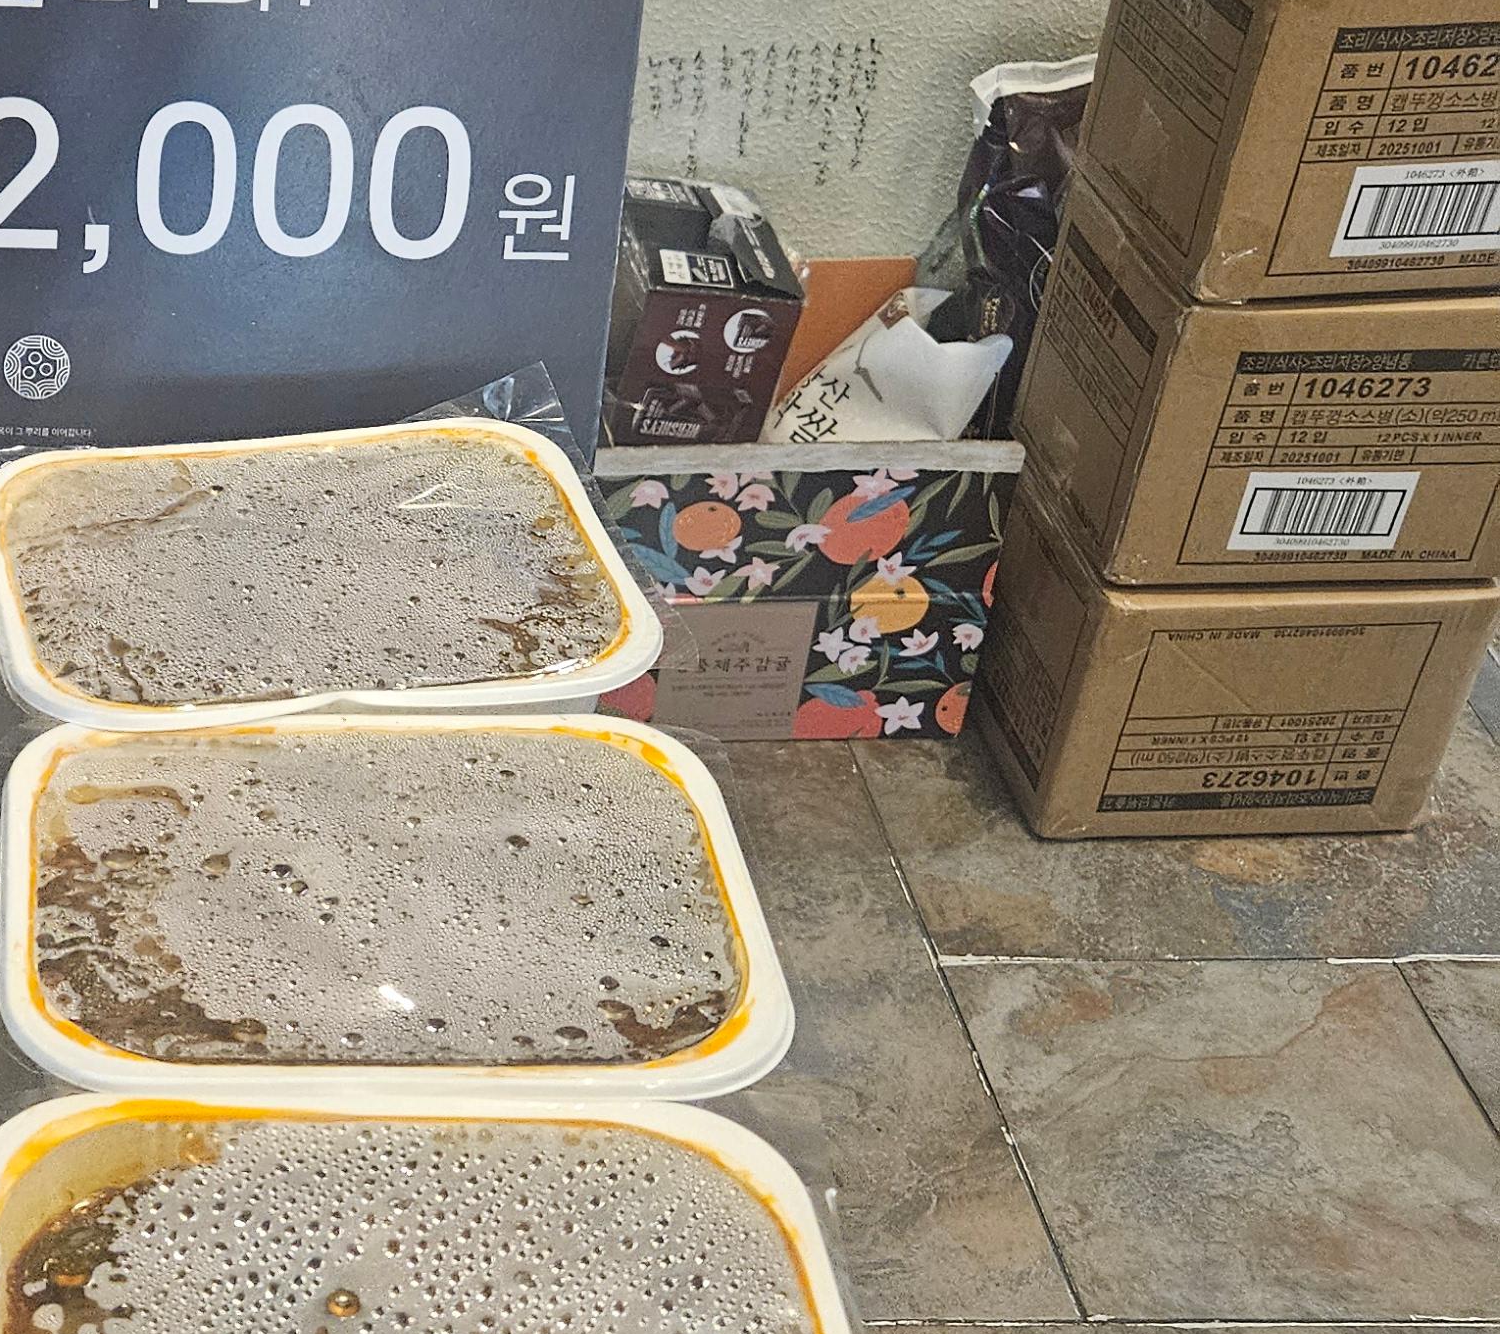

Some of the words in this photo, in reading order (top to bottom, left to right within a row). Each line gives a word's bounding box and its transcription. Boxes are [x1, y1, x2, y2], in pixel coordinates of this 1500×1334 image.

[1378, 140, 1442, 156] 20251001
[497, 170, 578, 261] 원
[1459, 252, 1497, 264] MADE
[1303, 376, 1433, 399] 1046273
[1279, 452, 1341, 463] 20251001
[1361, 550, 1397, 560] MADE
[1400, 550, 1414, 559] IN
[1419, 550, 1457, 560] CHINA
[1167, 632, 1201, 641] CHINA
[1208, 631, 1223, 640] IN
[1225, 630, 1260, 640] MADE
[1201, 769, 1317, 788] 1046273
